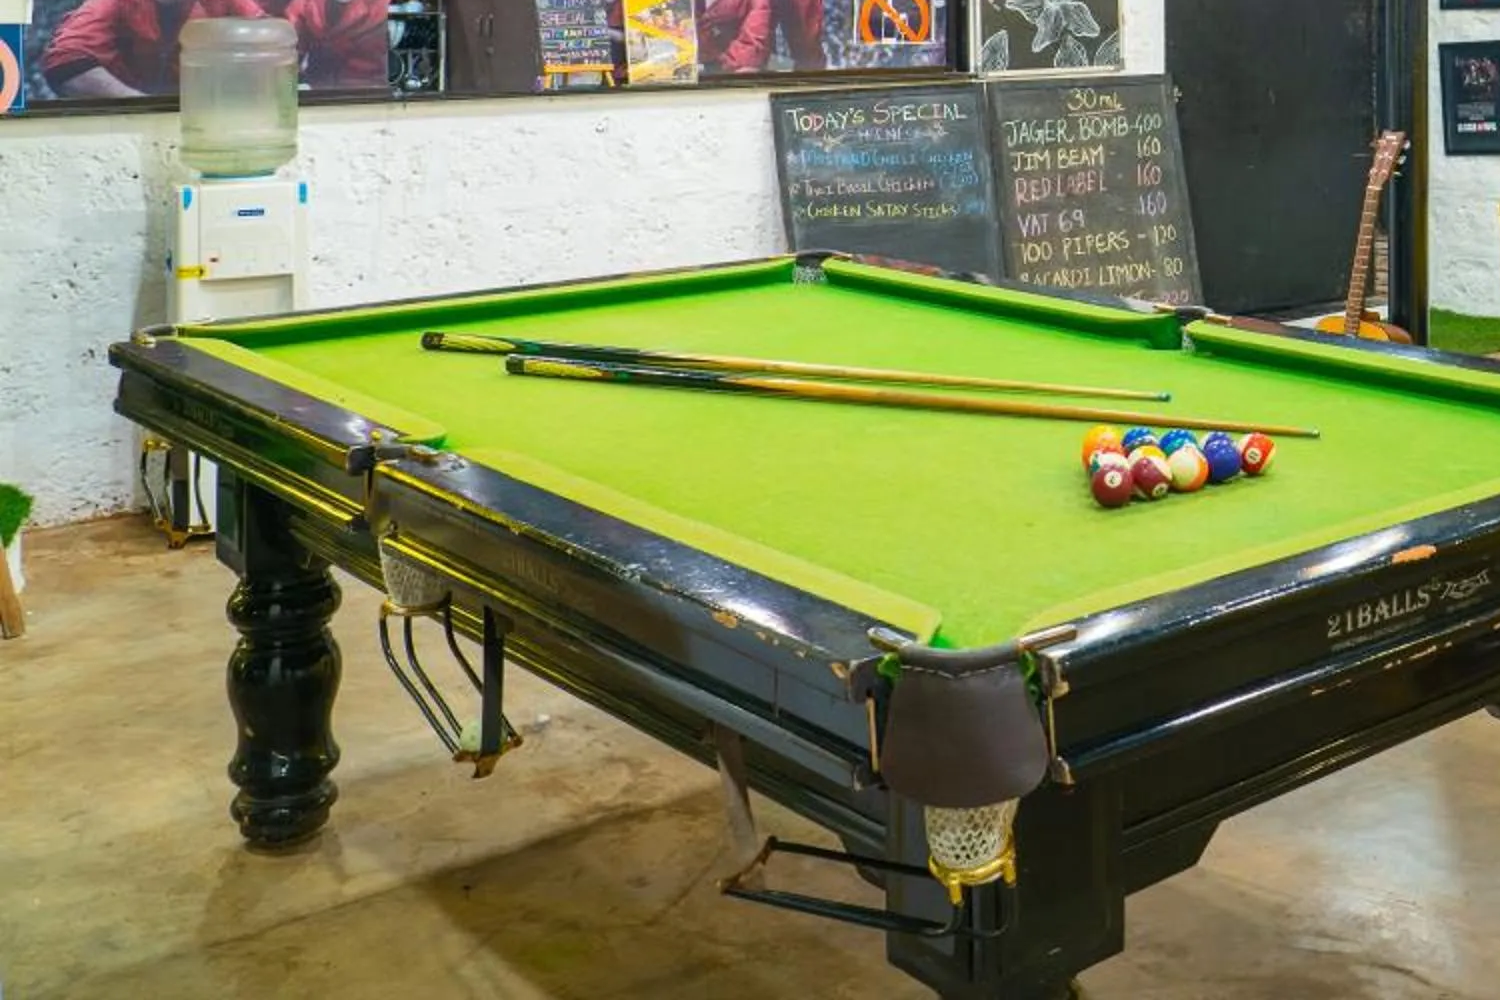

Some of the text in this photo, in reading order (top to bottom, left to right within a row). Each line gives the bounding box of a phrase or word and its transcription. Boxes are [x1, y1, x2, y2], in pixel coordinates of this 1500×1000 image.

[872, 100, 968, 125] SPECIAL
[1001, 118, 1073, 148] JAGER
[1010, 149, 1051, 172] JIM
[1057, 144, 1105, 169] BEAM
[1136, 135, 1162, 159] 160
[1014, 175, 1050, 206] RED
[1056, 170, 1108, 198] LABEL
[1136, 160, 1162, 186] 160
[1017, 213, 1050, 238] VAT
[1058, 208, 1085, 233] 69
[1138, 191, 1167, 217] 160
[1013, 242, 1052, 265] 100
[1062, 231, 1130, 260] PIPERS
[1163, 256, 1184, 279] 80
